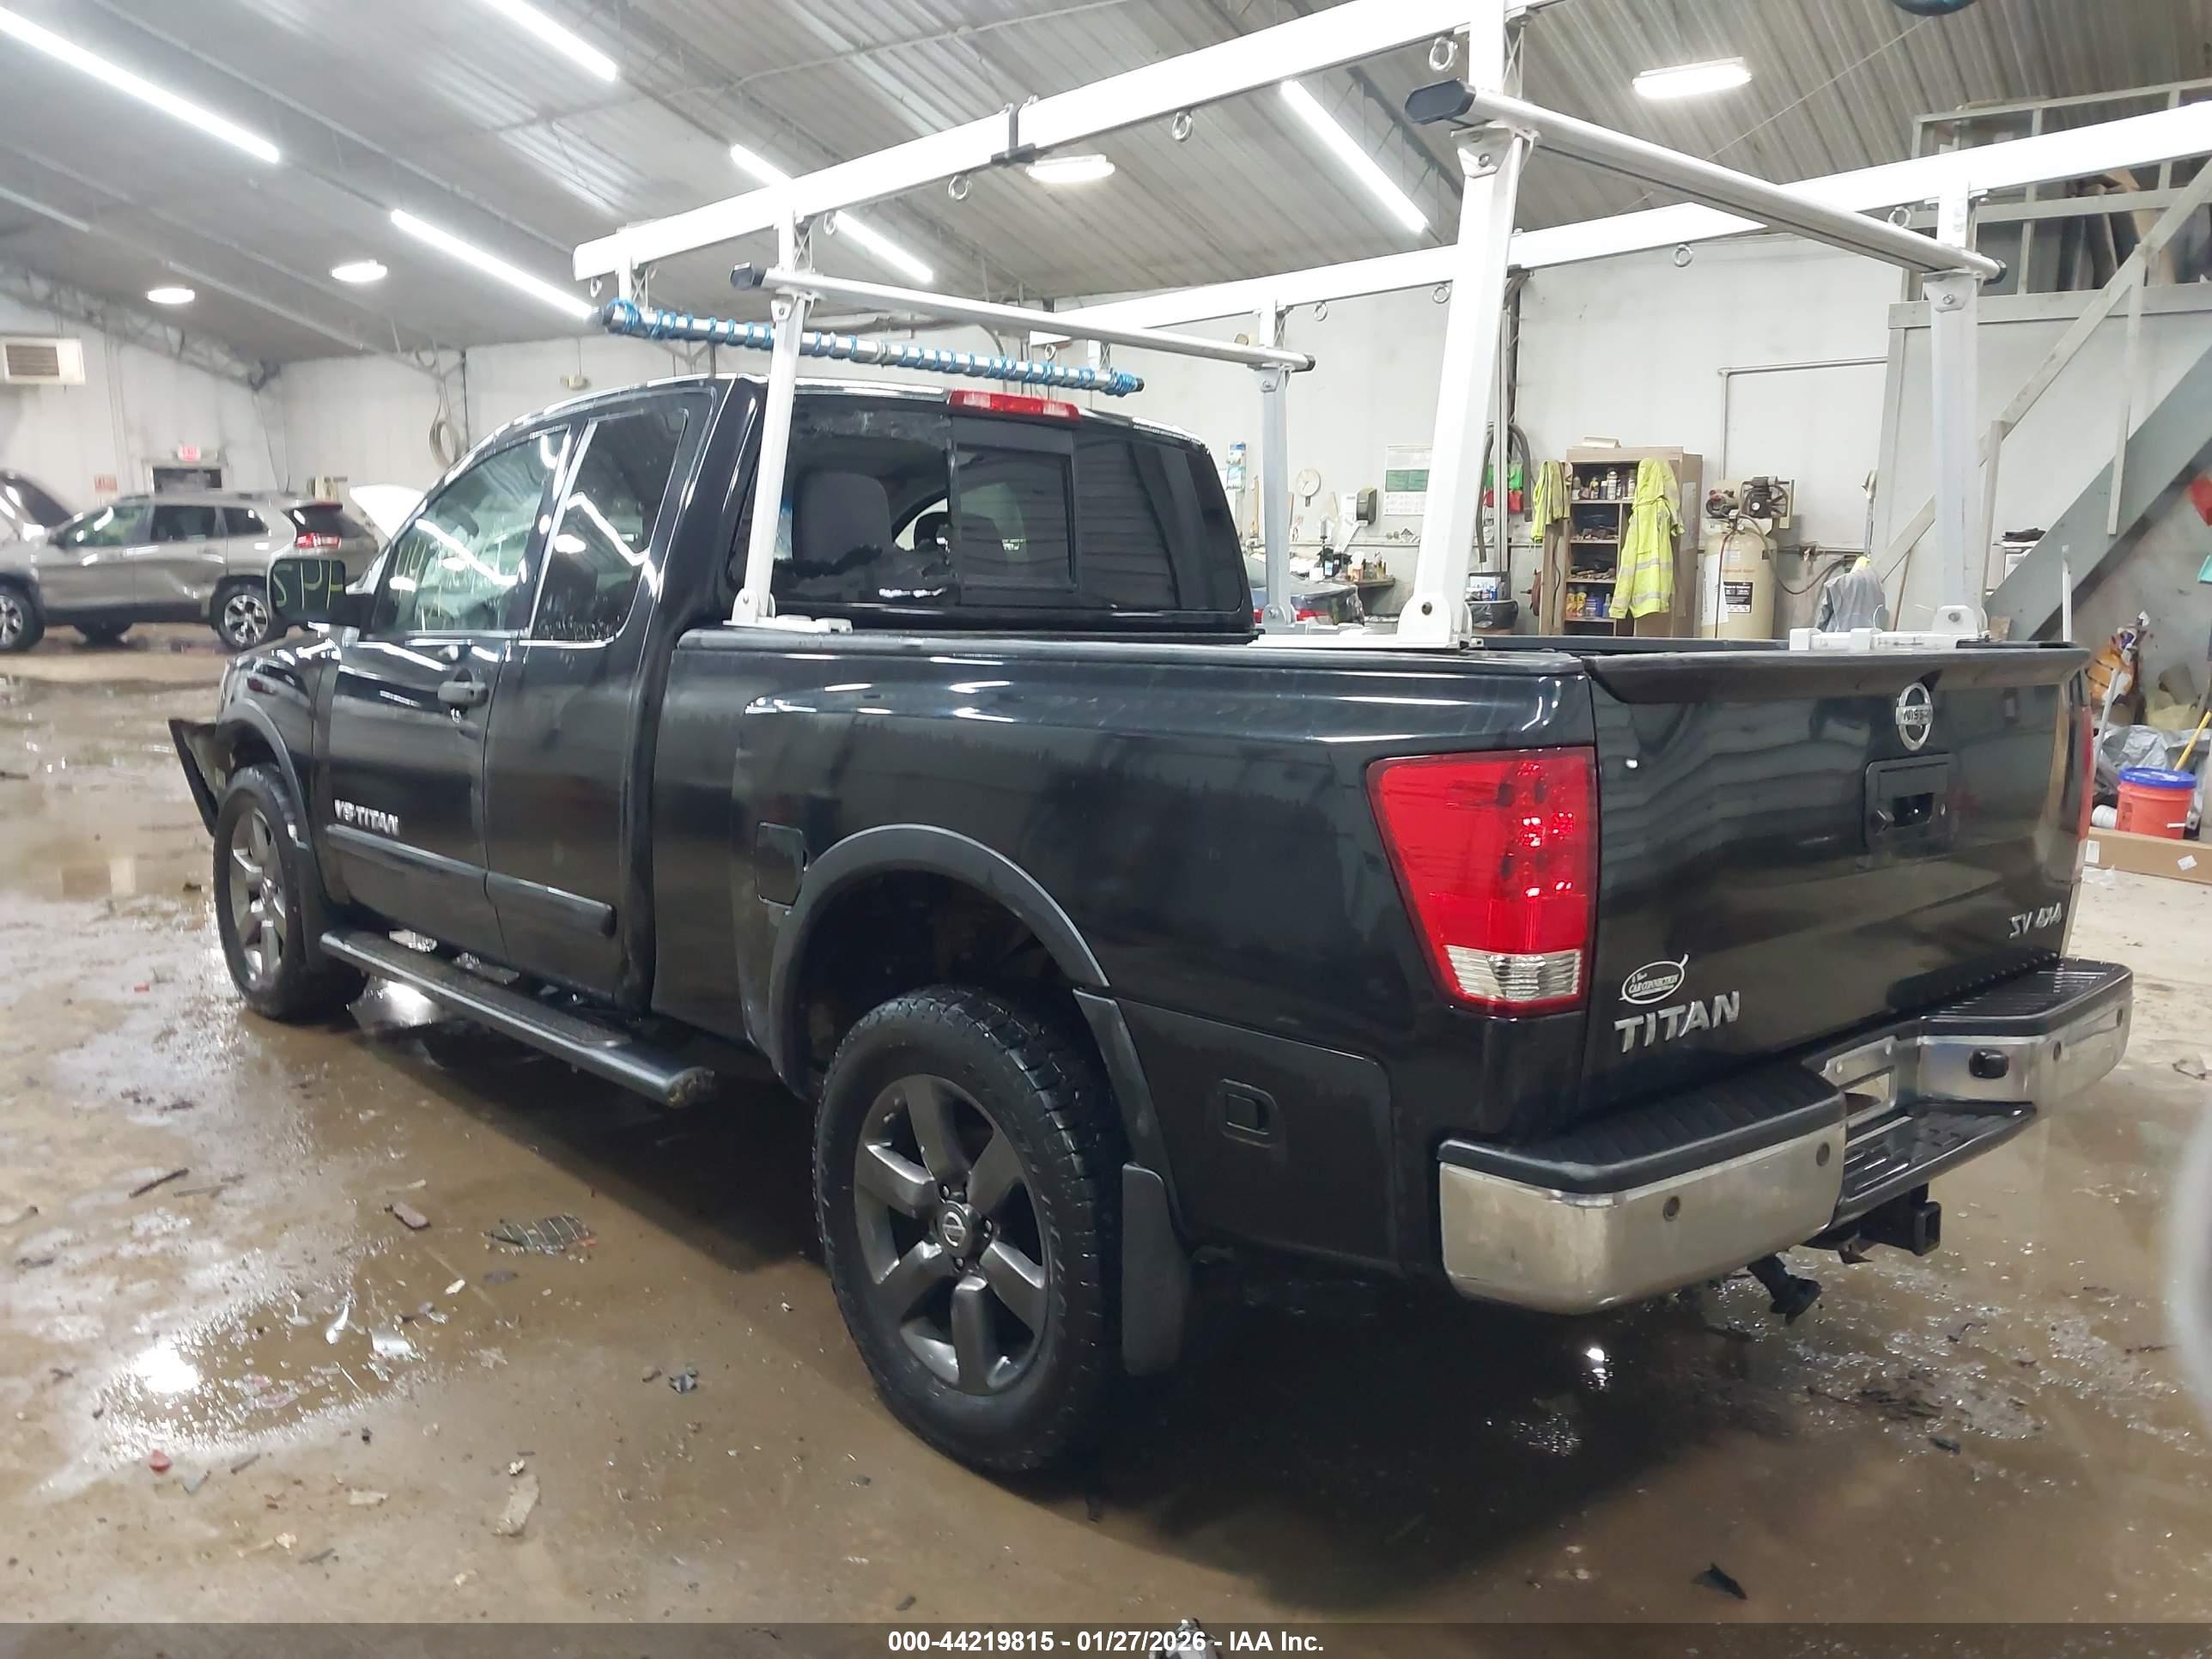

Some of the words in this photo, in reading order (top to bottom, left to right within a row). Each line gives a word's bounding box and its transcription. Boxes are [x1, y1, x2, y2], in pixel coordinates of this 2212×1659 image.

[1903, 708, 1931, 722] NISS
[333, 799, 356, 823] V8
[355, 805, 400, 836] TITAN
[2008, 912, 2033, 939] SV
[1613, 989, 1741, 1054] TITAN
